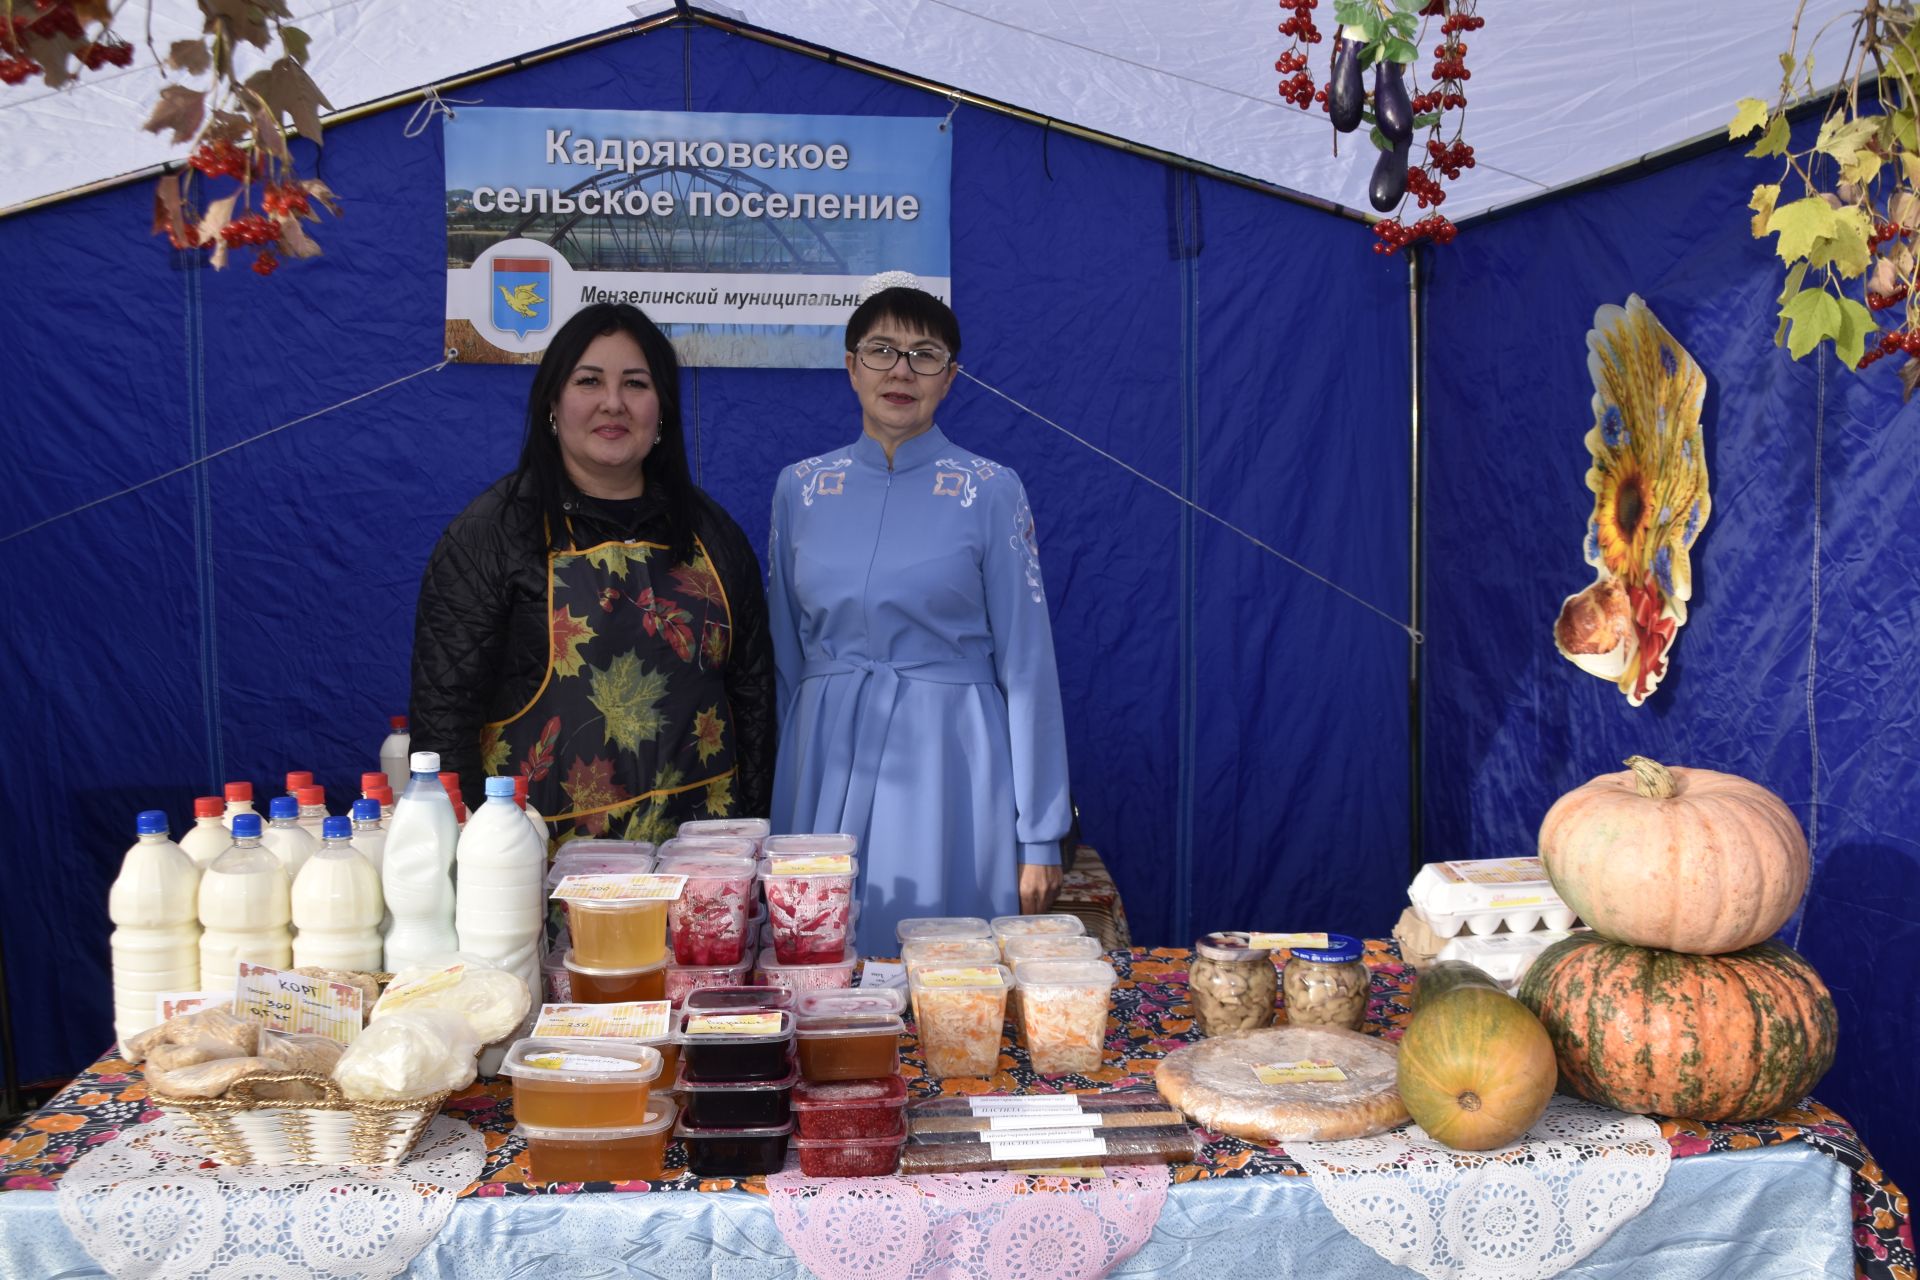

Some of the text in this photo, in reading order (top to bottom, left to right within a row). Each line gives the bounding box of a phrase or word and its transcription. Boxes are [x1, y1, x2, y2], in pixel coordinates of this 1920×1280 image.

[545, 129, 851, 173] Кадряковское
[472, 185, 920, 221] сельское поселение
[581, 286, 863, 309] Мензелинский муниципальн
[279, 979, 319, 997] КОРТ
[265, 999, 292, 1010] 300
